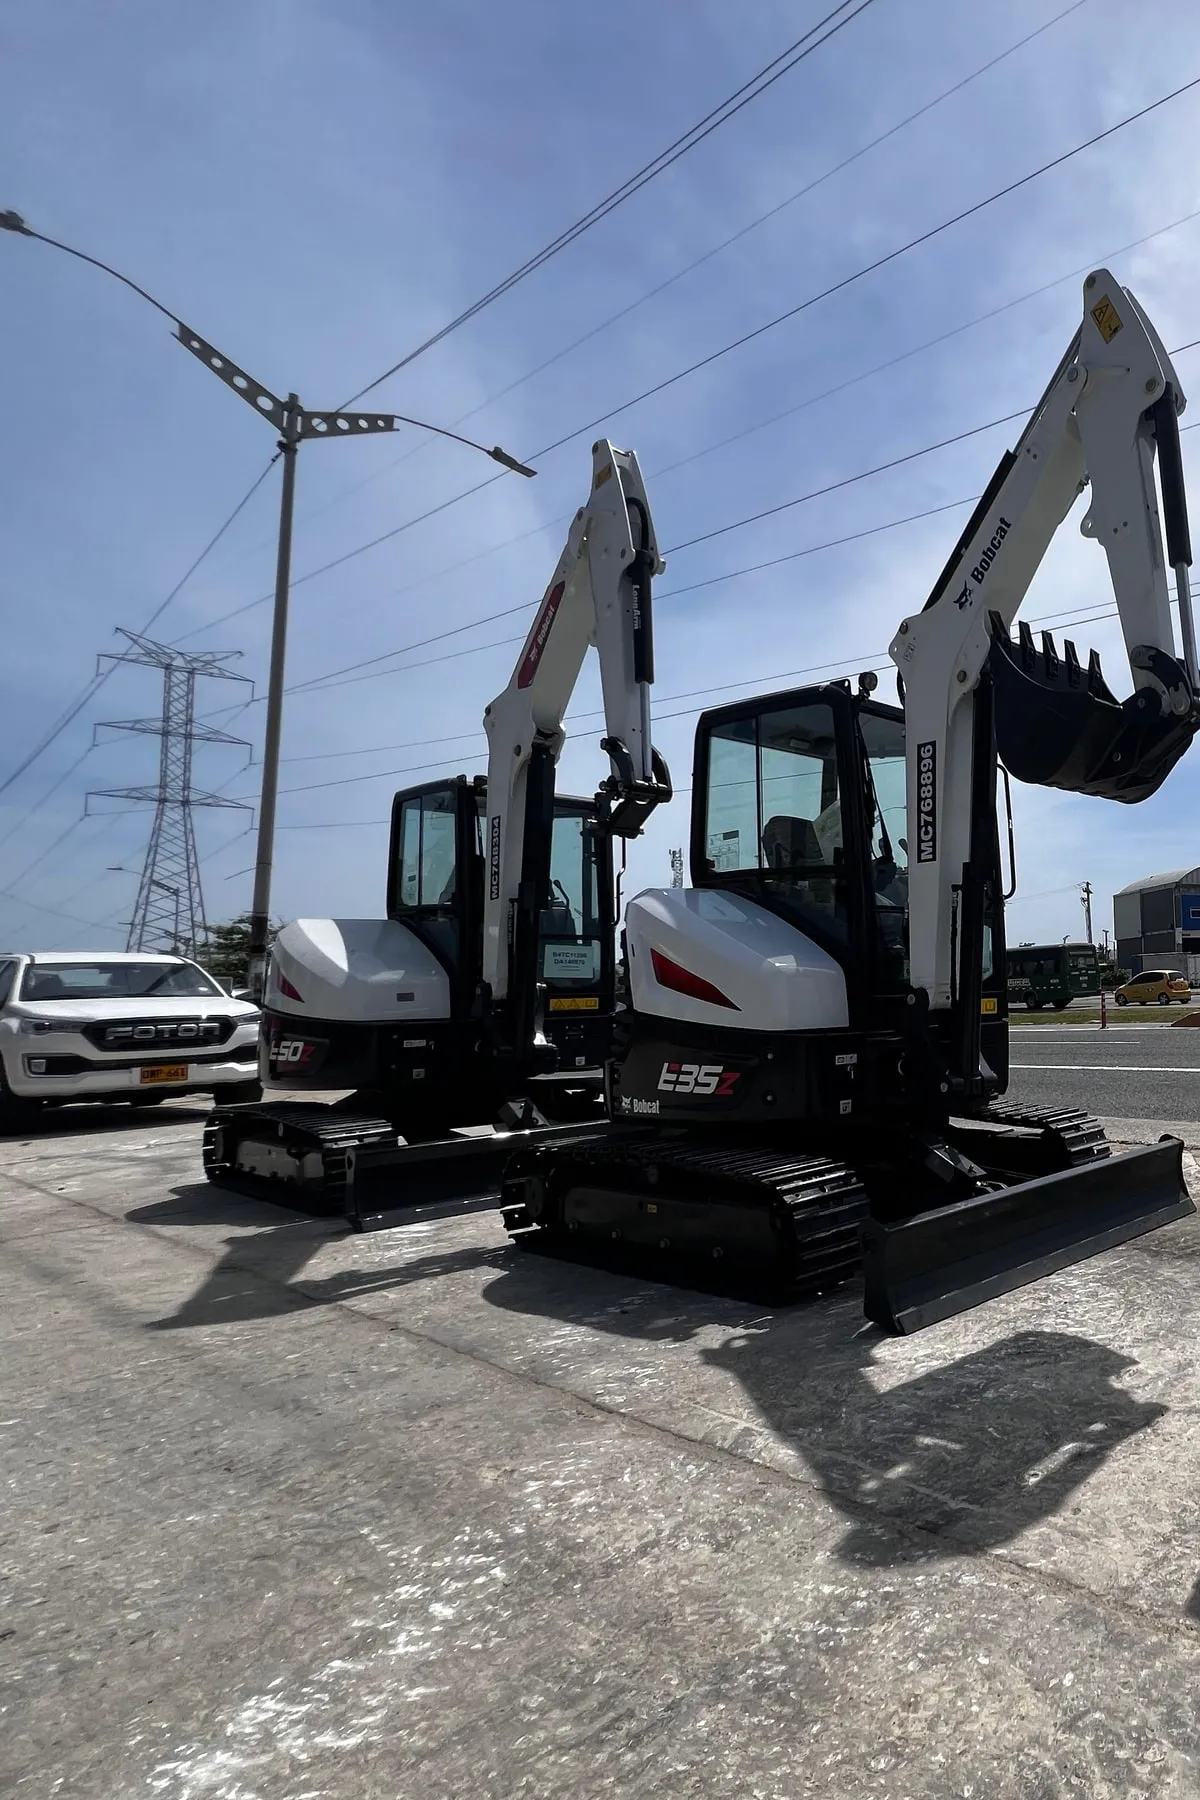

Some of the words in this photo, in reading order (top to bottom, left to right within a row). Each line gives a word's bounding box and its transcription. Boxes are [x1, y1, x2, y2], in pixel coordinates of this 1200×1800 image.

[970, 516, 1012, 585] Bobcat
[920, 744, 933, 861] MC768896
[105, 1022, 220, 1041] FOTON
[633, 1098, 660, 1114] Bobcat
